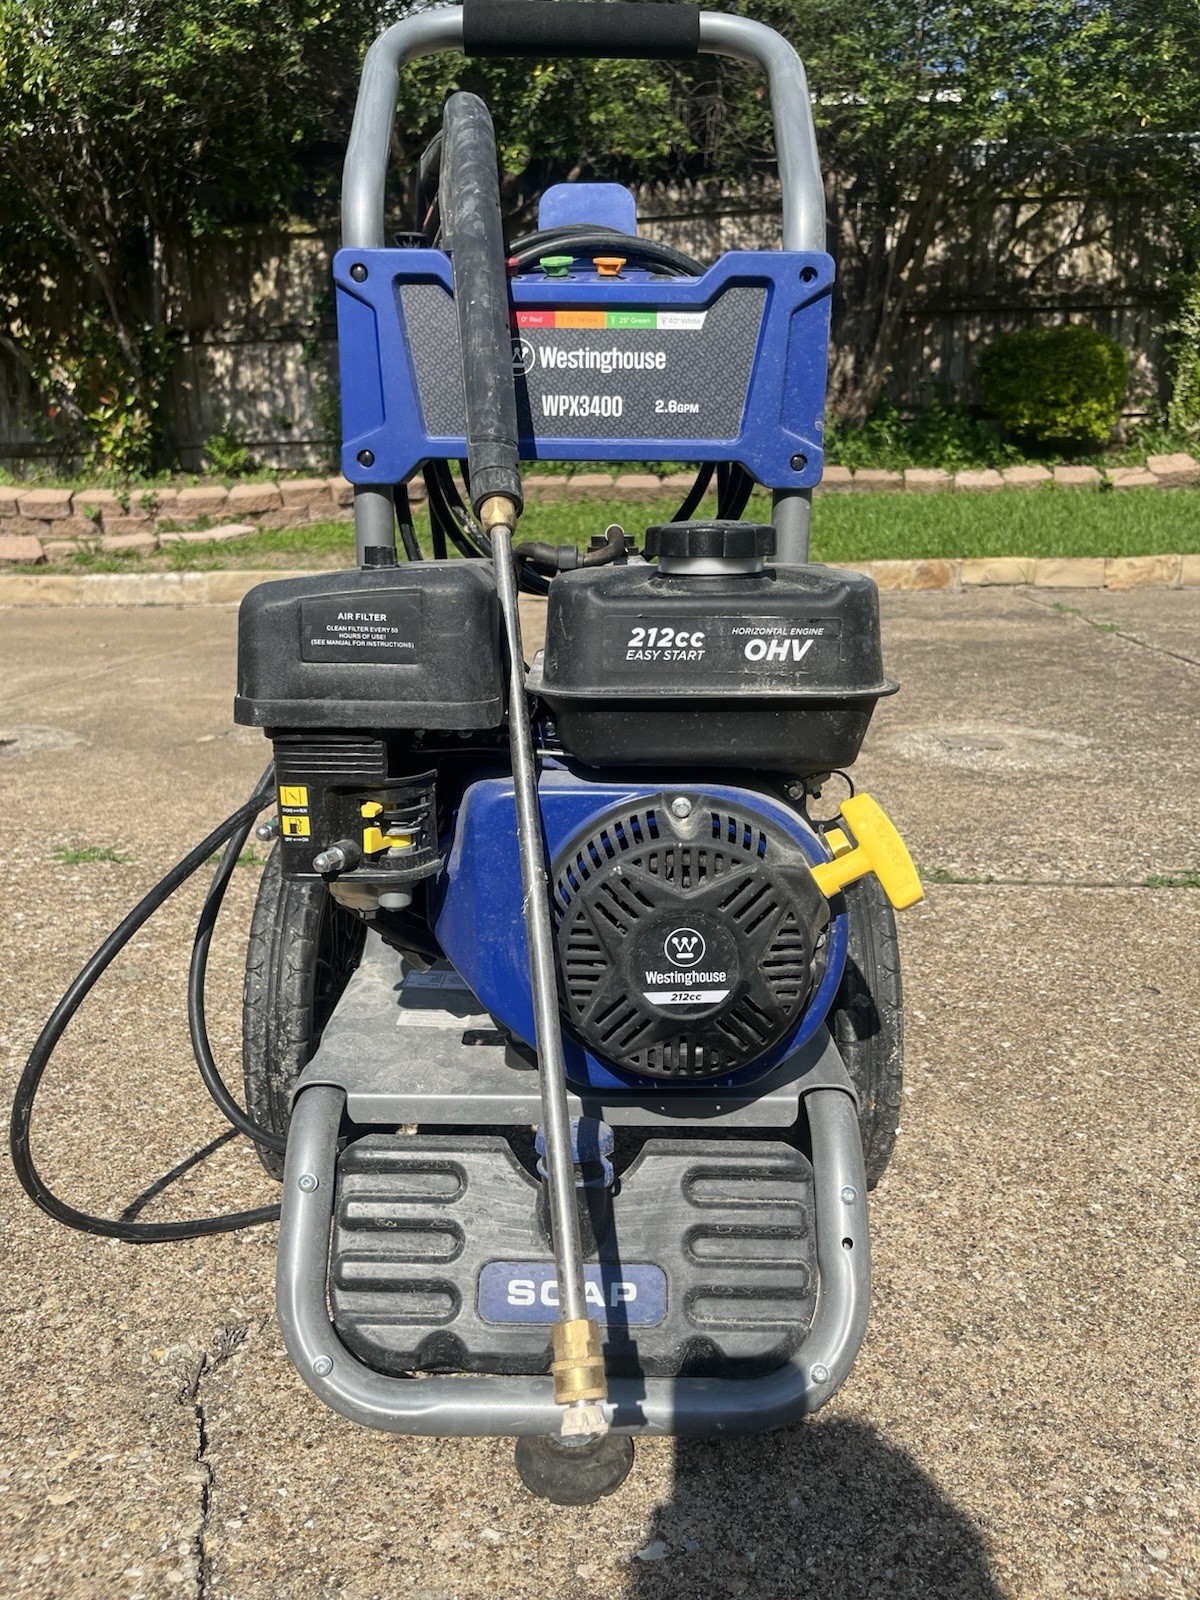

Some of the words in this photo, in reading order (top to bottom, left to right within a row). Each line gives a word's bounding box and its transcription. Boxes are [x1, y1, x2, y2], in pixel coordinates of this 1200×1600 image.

[539, 346, 667, 374] Westinghouse
[541, 395, 623, 417] WPX3400
[337, 612, 354, 620] AIR
[355, 613, 387, 621] FILTER
[627, 627, 706, 648] 212cc
[731, 627, 788, 636] HORIZONTAL
[789, 627, 825, 636] ENGINE
[326, 639, 352, 647] MANUAL
[366, 641, 415, 649] INSTRUCTIONS)
[744, 638, 814, 661] OHV
[625, 650, 661, 661] EASY
[663, 650, 706, 661] START
[645, 970, 727, 986] Westinghouse
[670, 993, 702, 1002] 212cc
